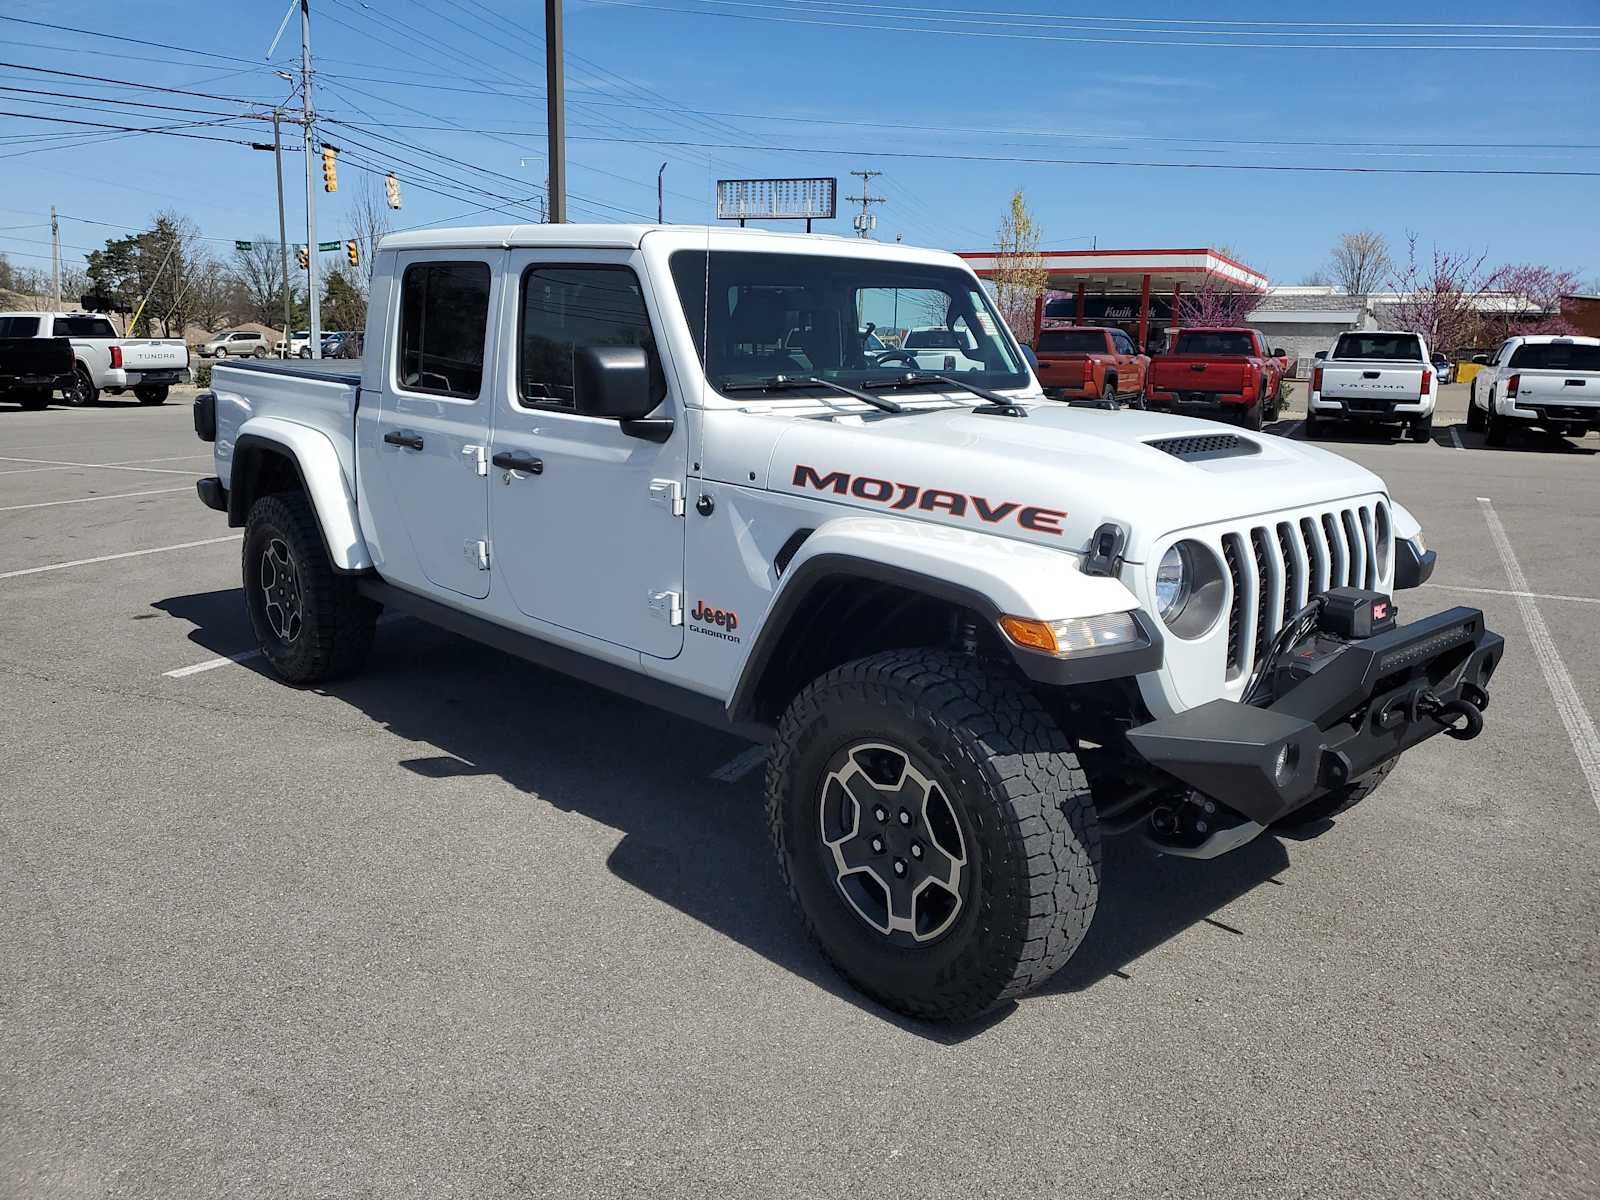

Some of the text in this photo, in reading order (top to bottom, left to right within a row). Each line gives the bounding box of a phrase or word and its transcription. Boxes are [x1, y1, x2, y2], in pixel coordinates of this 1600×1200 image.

[1104, 306, 1132, 318] Kwik
[792, 464, 1068, 536] MOJAVE
[691, 600, 738, 632] Jeep
[689, 624, 741, 644] GLADIATOR
